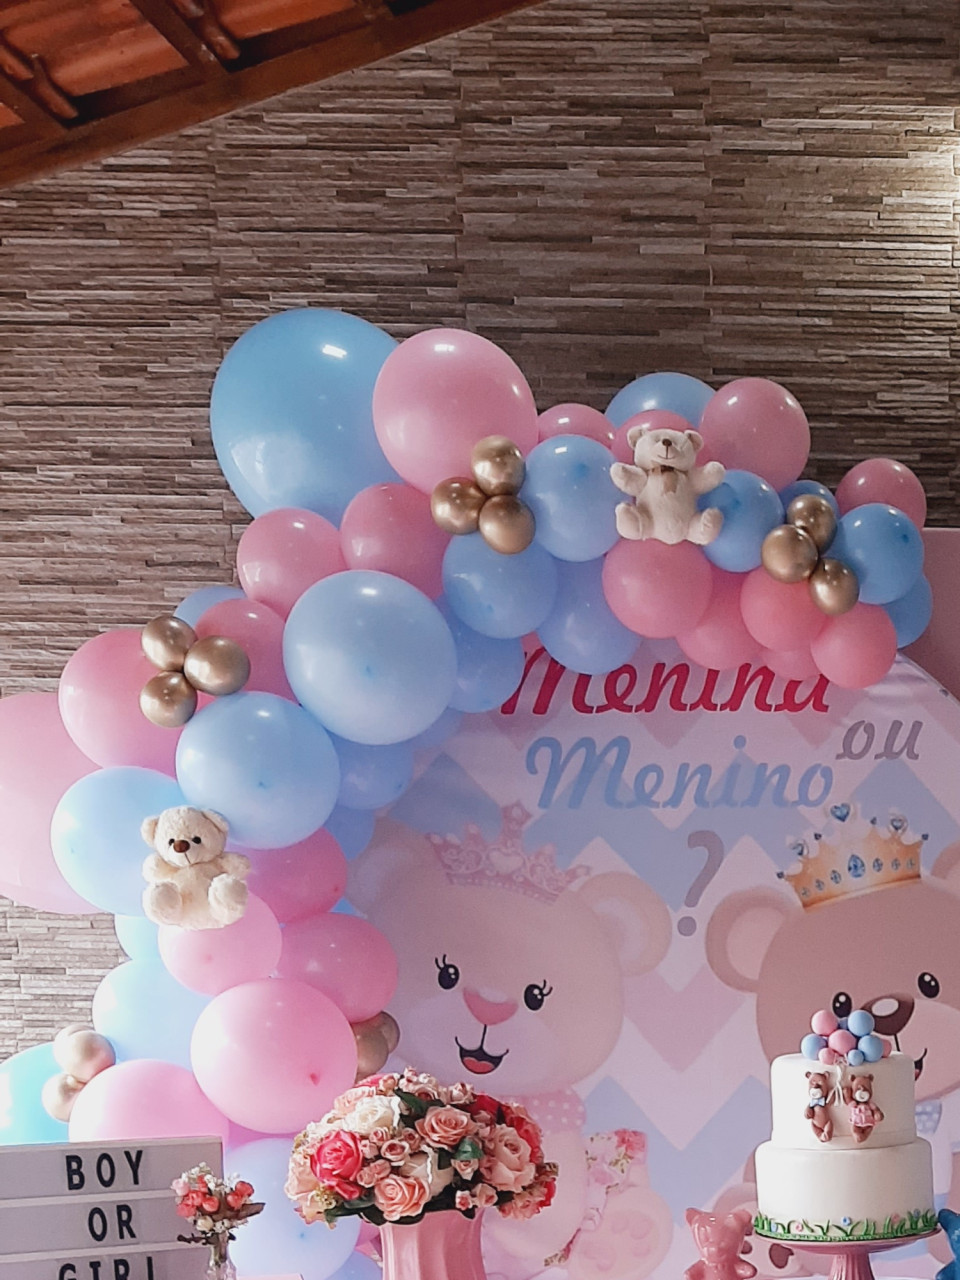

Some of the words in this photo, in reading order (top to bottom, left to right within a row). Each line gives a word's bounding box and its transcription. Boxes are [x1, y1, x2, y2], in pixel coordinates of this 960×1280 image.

[835, 719, 924, 761] ou
[525, 734, 834, 810] Menino
[676, 829, 725, 937] ?
[65, 1150, 143, 1190] BOY
[88, 1204, 136, 1242] OR
